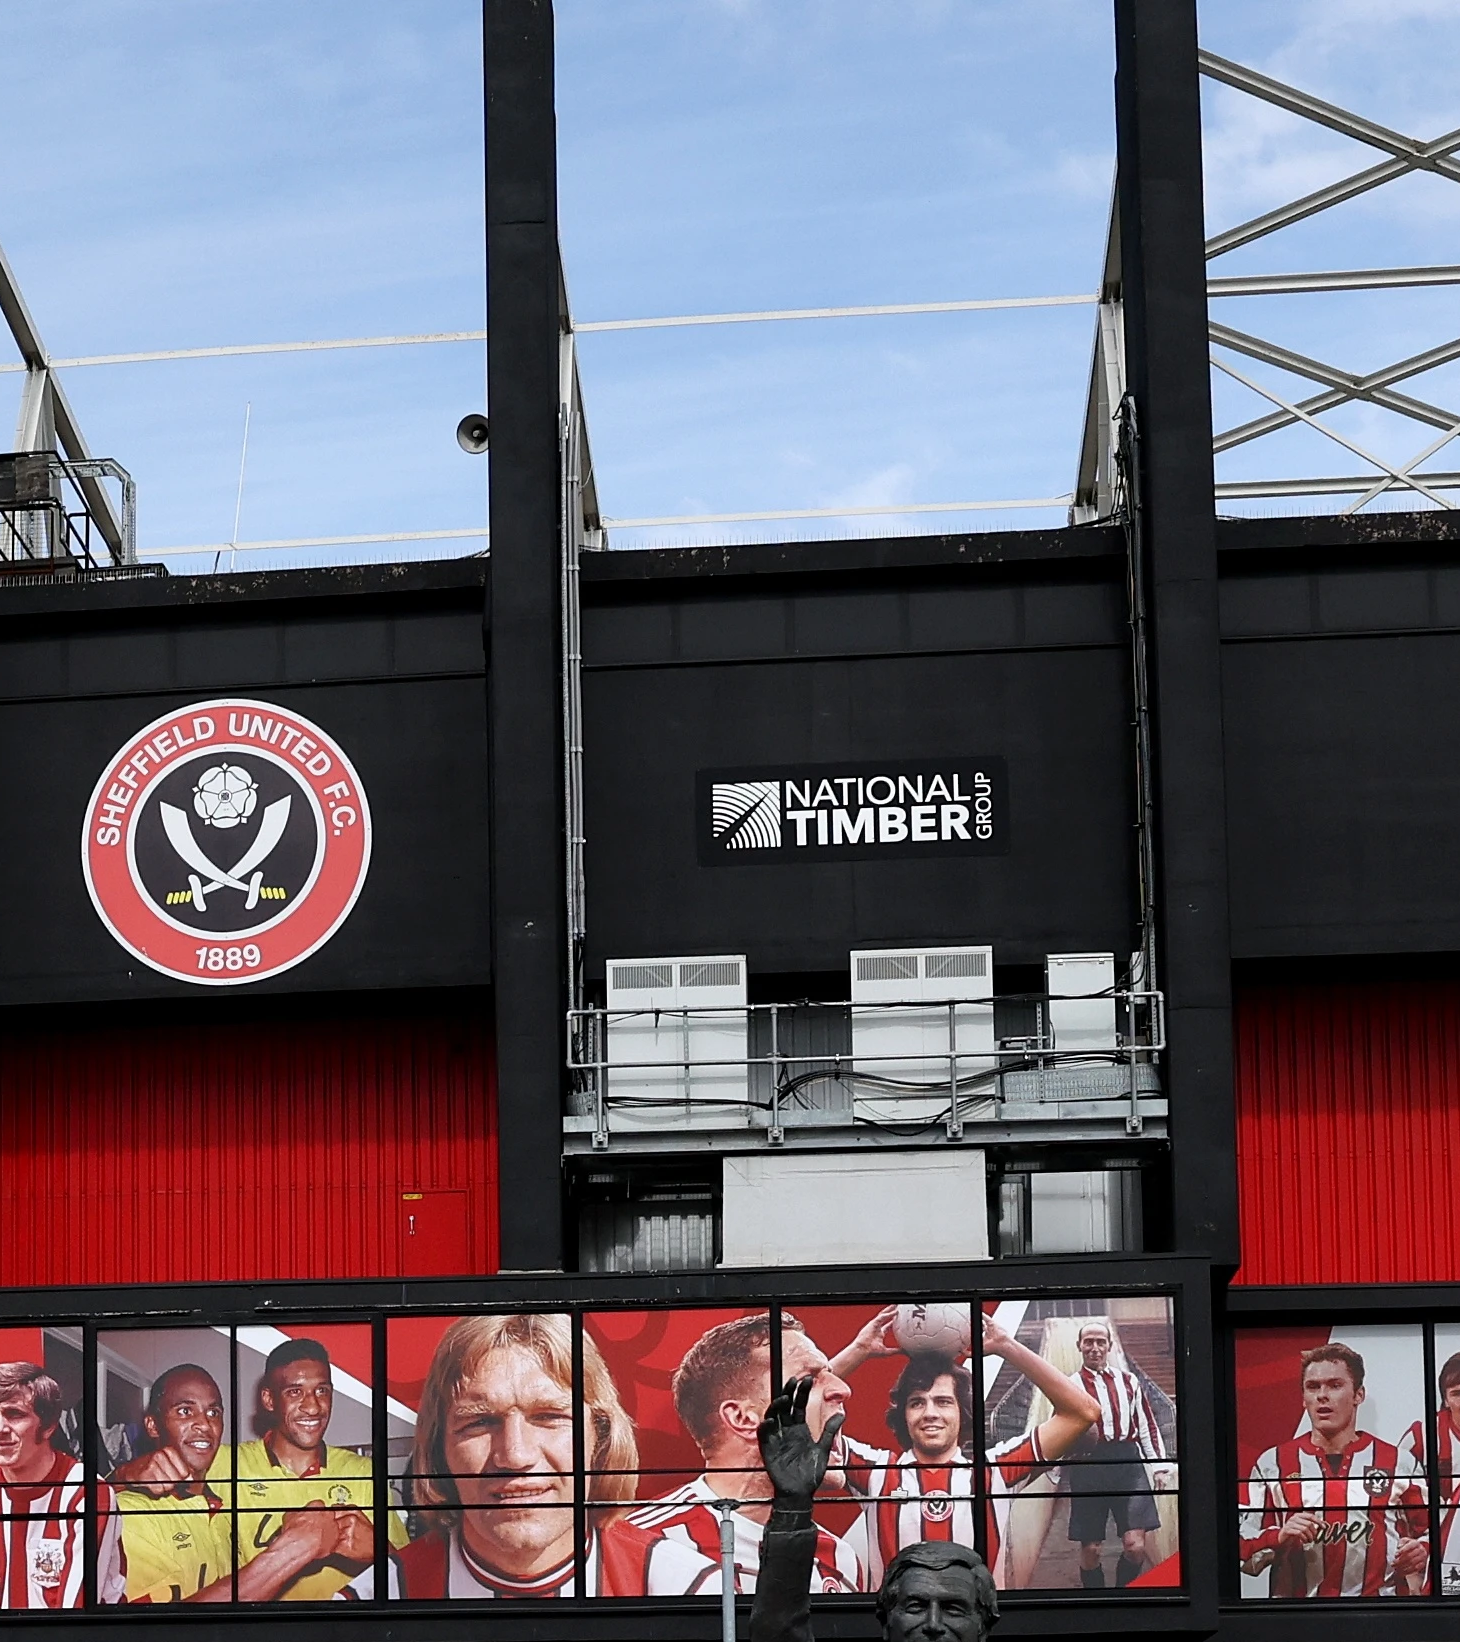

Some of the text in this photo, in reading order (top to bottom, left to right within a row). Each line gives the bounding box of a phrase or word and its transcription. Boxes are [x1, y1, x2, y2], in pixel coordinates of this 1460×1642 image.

[96, 712, 357, 847] SHEFFIELD UNITED F.C.
[785, 773, 972, 809] NATIONAL
[786, 804, 972, 847] TIMBER
[974, 772, 993, 840] GROUP
[194, 943, 262, 971] 1889
[1313, 1519, 1375, 1546] aver
